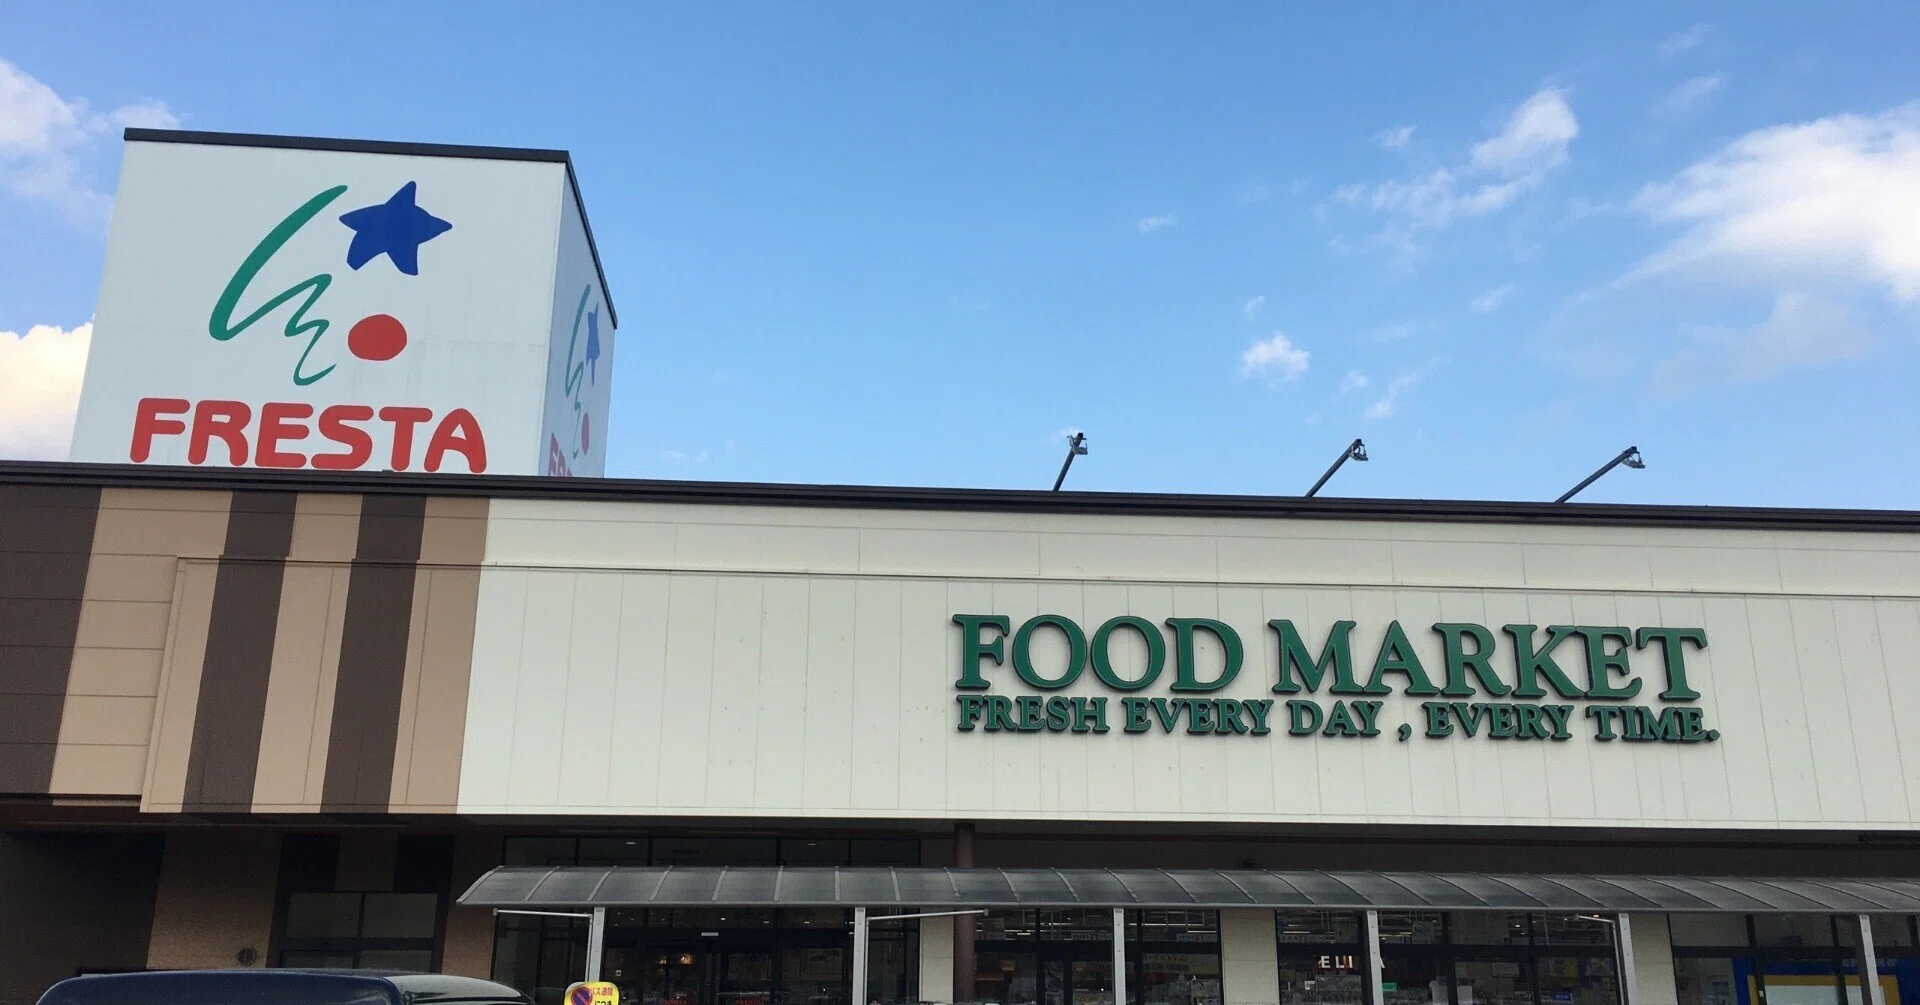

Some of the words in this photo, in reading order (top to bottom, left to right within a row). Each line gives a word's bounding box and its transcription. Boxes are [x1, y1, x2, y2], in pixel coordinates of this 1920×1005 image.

[130, 398, 487, 474] FRESTA
[952, 613, 1244, 696] FOOD
[1268, 619, 1708, 704] MARKET
[956, 694, 1111, 736] FRESH
[1121, 696, 1275, 738] EVERY
[1421, 701, 1575, 743] EVERY
[1585, 704, 1721, 746] TIME.
